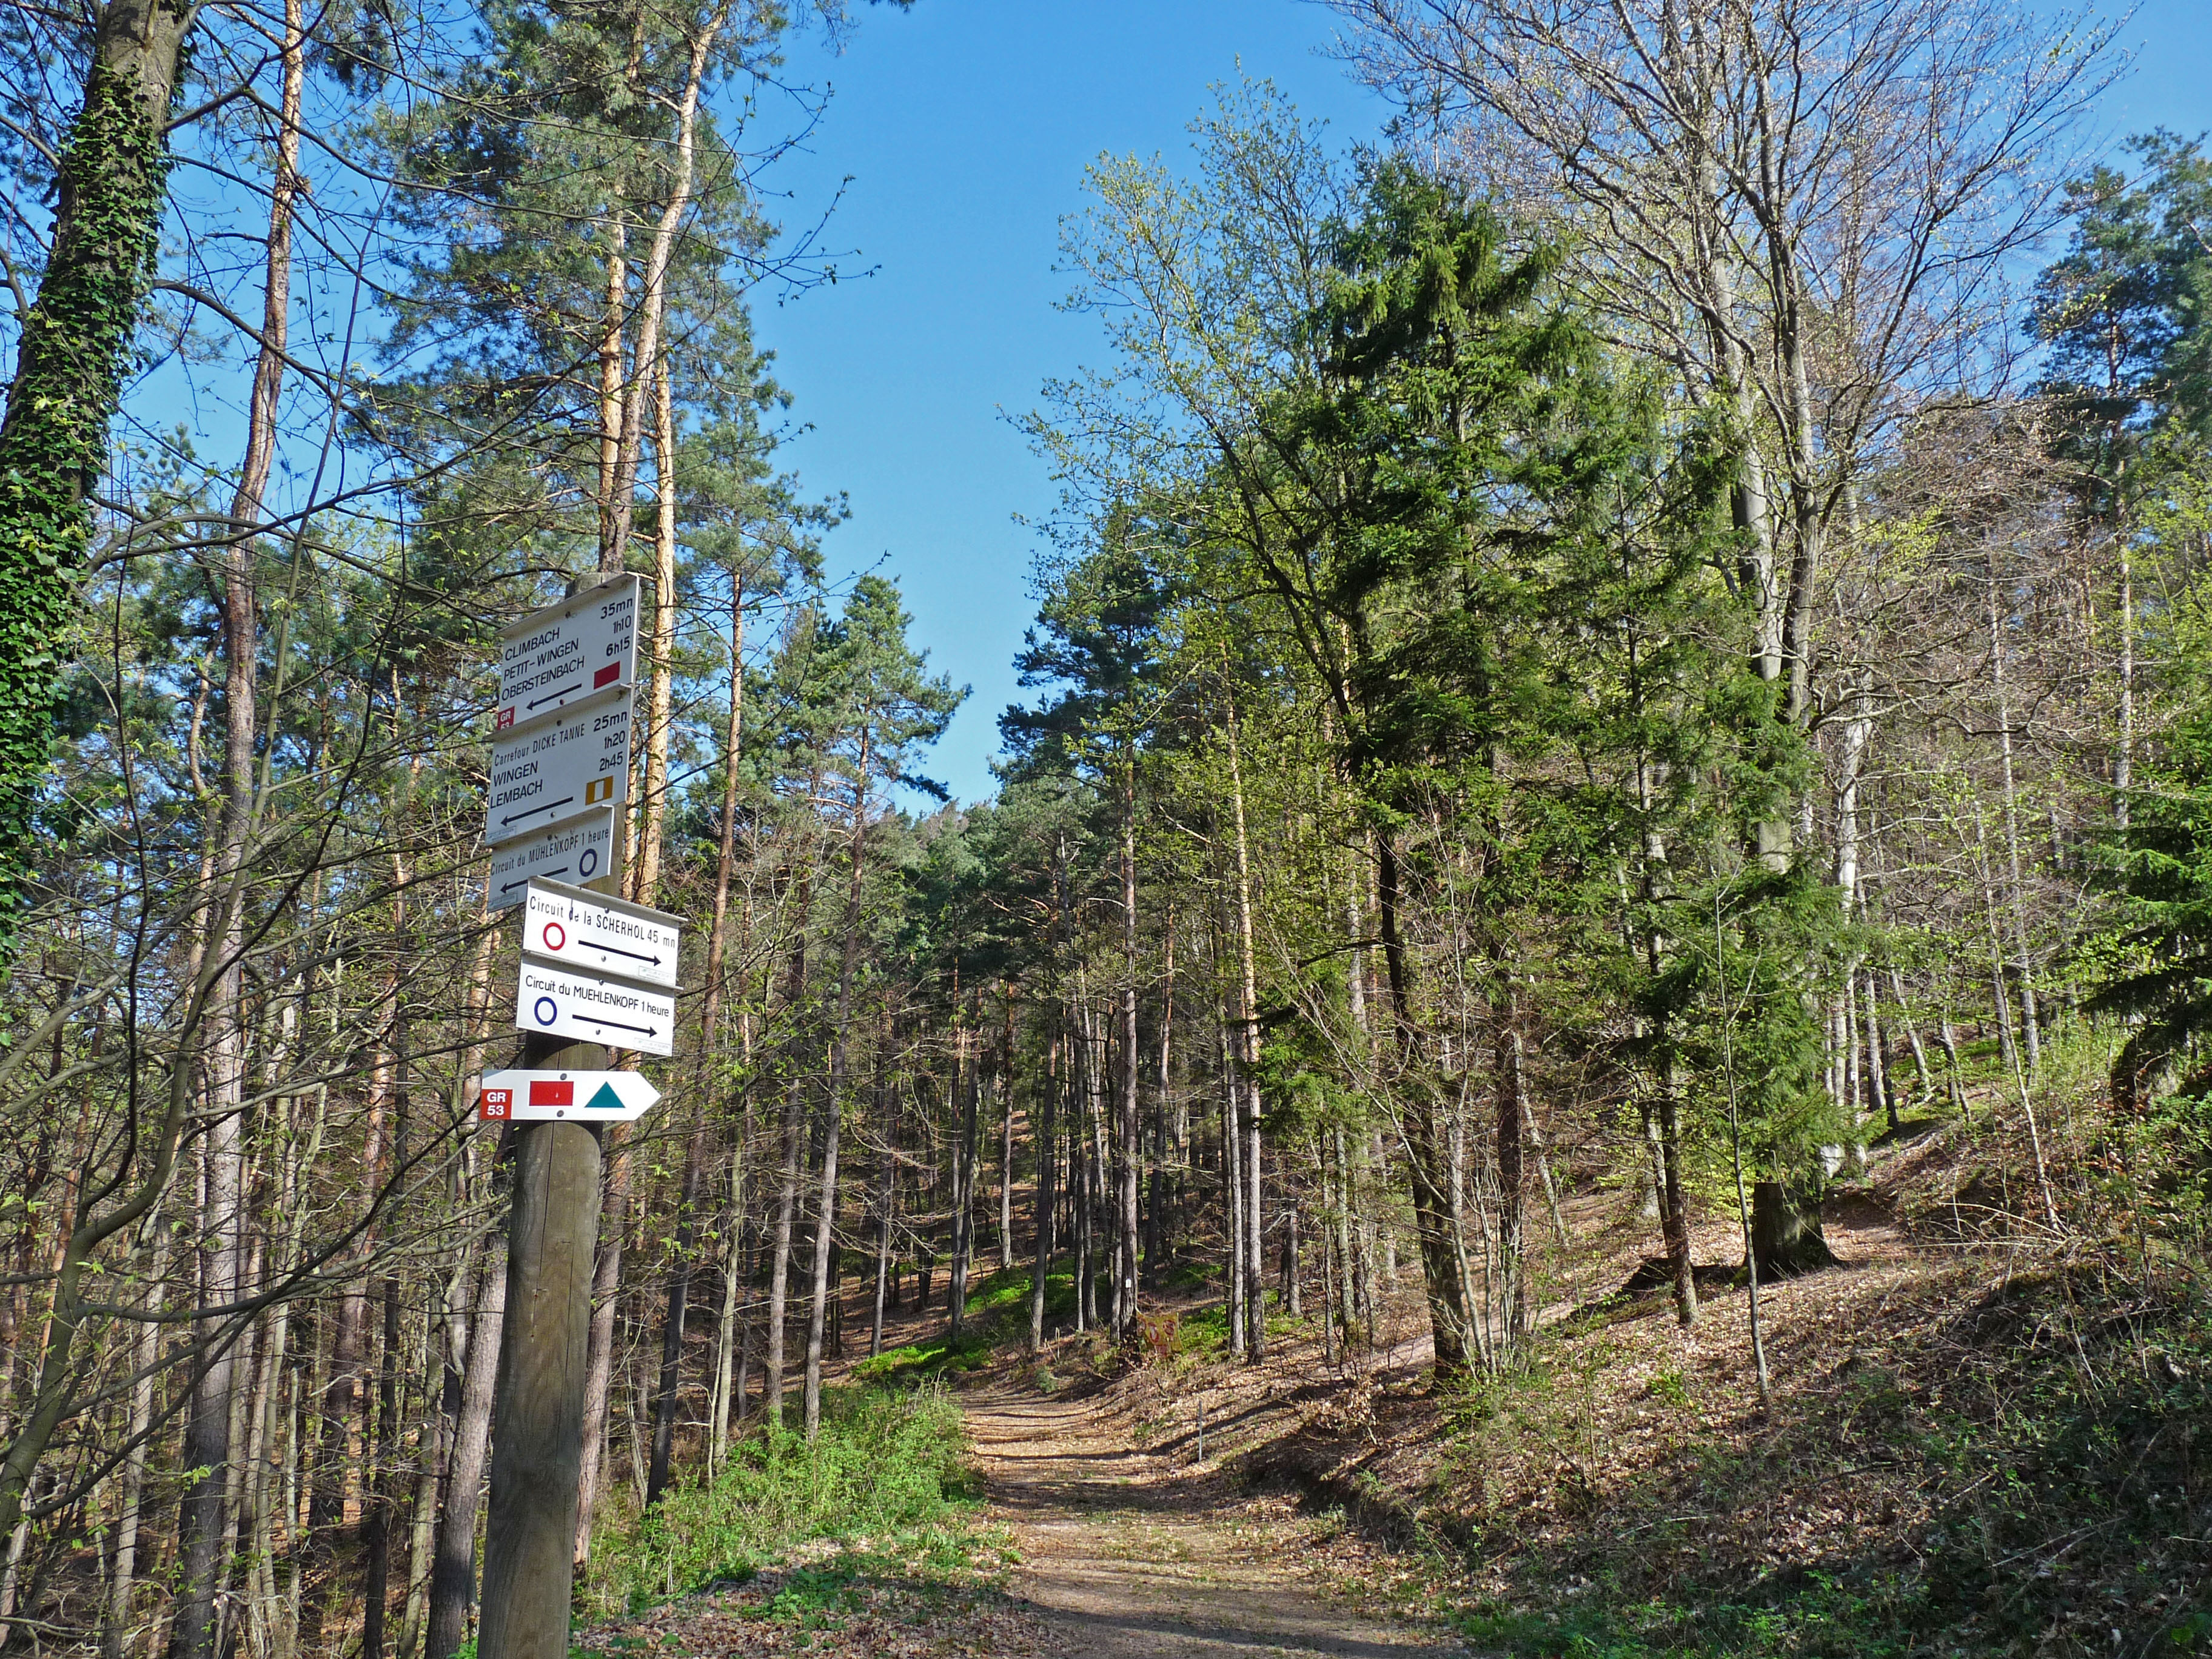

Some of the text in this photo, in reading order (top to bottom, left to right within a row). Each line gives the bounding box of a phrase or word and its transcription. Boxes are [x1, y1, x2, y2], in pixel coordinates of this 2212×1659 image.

[505, 597, 633, 661] CLIMBACH 35mn
[613, 615, 632, 634] 1h10
[501, 636, 630, 701] OBERSTEINBACH 6h15
[494, 711, 627, 766] Carrefour DICKE TANNE 25mn
[500, 711, 511, 722] GR
[490, 751, 623, 809] LEMBACH 2h45
[494, 730, 625, 787] WINGEN 1h20
[491, 857, 514, 875] Circuit
[517, 854, 525, 867] du
[528, 834, 578, 863] MÜHLENKOPF
[581, 833, 585, 846] 1
[588, 828, 609, 843] heure
[530, 896, 564, 918] Circuit
[569, 907, 579, 922] de
[584, 911, 591, 925] la
[596, 914, 645, 940] SCHERHOL
[647, 929, 659, 943] 45
[663, 936, 675, 948] mn
[525, 975, 669, 1017] Circuit du MUEHLENKOPF 1 heure
[486, 1091, 506, 1103] GR
[487, 1105, 504, 1116] 53
